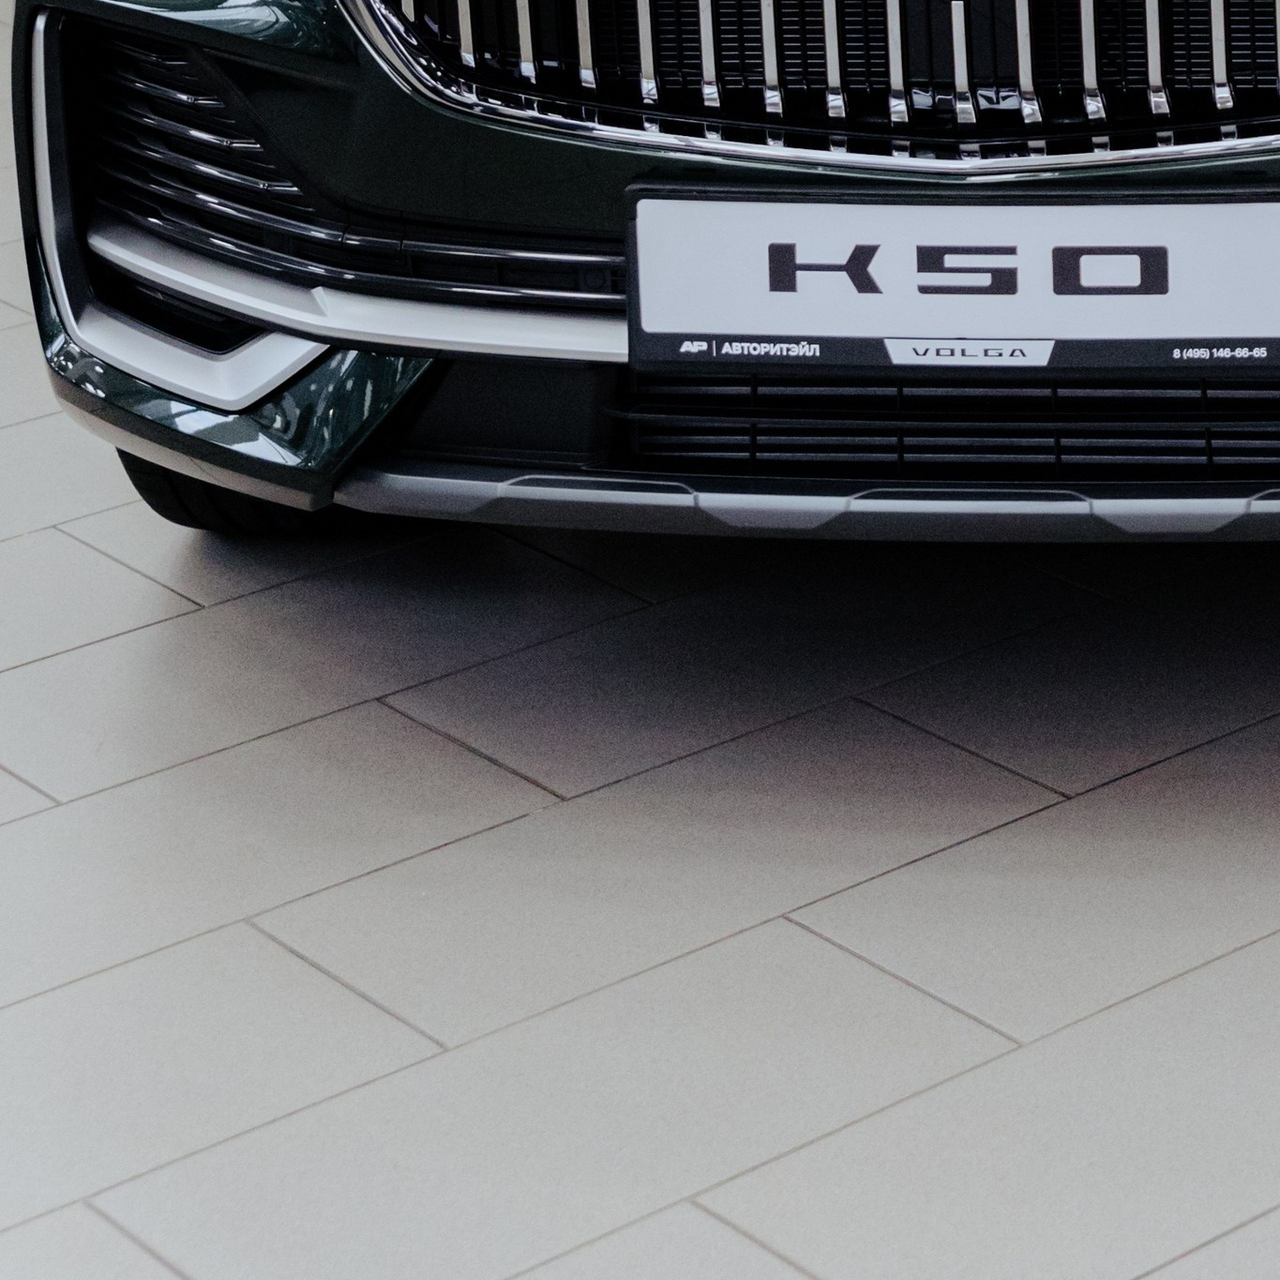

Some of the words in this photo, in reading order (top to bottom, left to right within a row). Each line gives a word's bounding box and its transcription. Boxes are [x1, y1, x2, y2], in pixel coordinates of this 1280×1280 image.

[721, 341, 821, 357] АВТОРИТЭЙЛ
[912, 347, 1028, 358] VOLGA
[1172, 348, 1181, 359] 8
[1182, 348, 1210, 360] (495)
[1211, 347, 1268, 358] 146-66-65
